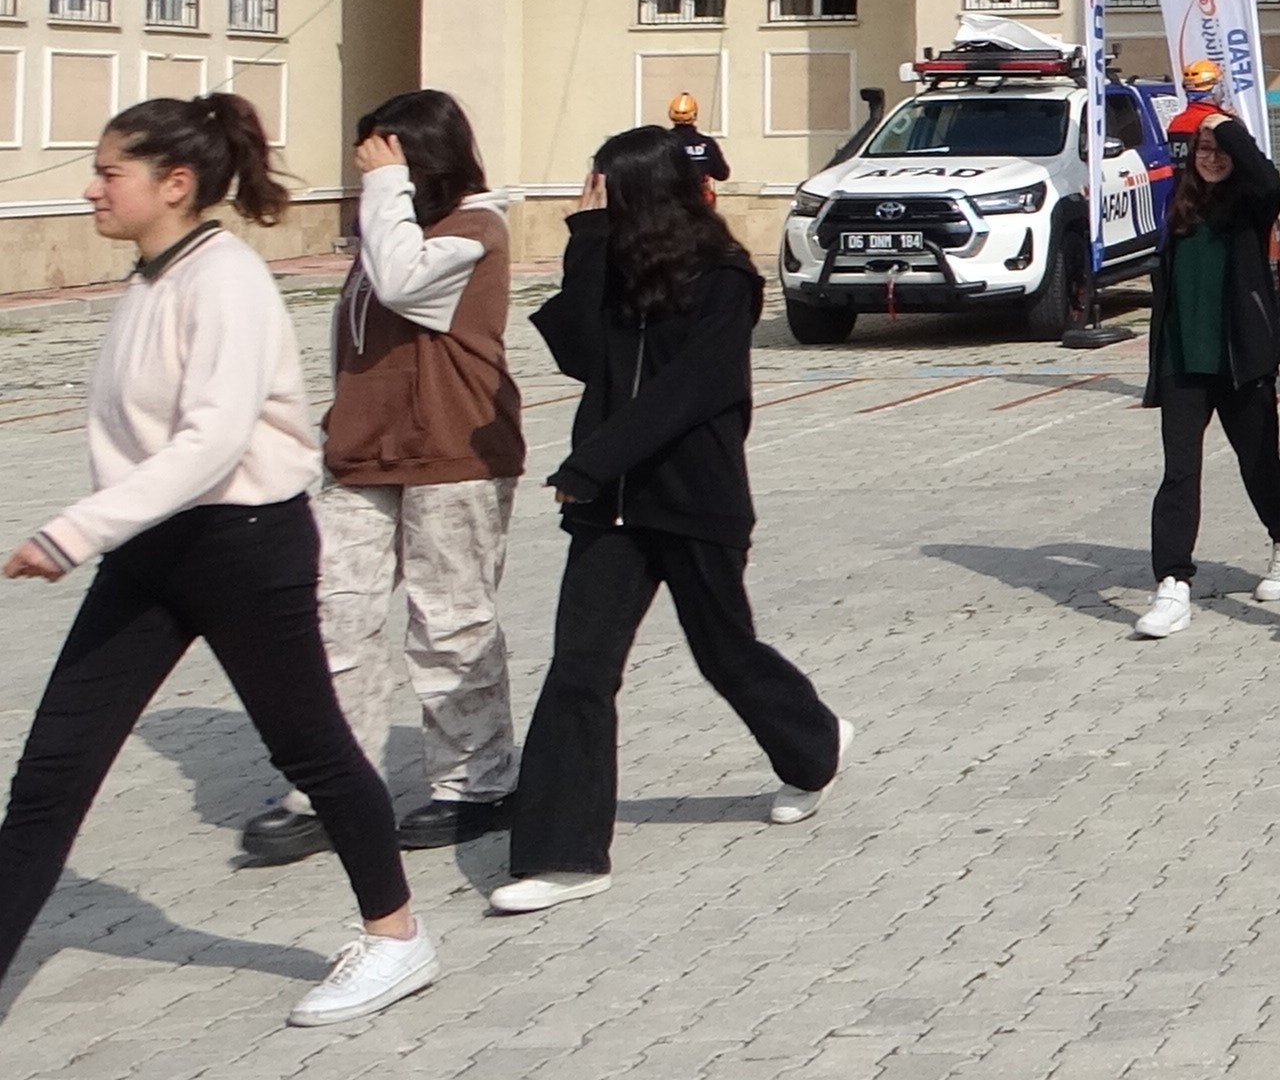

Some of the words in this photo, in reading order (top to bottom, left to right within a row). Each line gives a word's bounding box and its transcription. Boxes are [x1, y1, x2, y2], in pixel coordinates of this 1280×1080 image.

[854, 167, 986, 180] AFAD
[1102, 190, 1129, 223] AFAD
[848, 235, 864, 249] 06
[900, 234, 920, 248] 184
